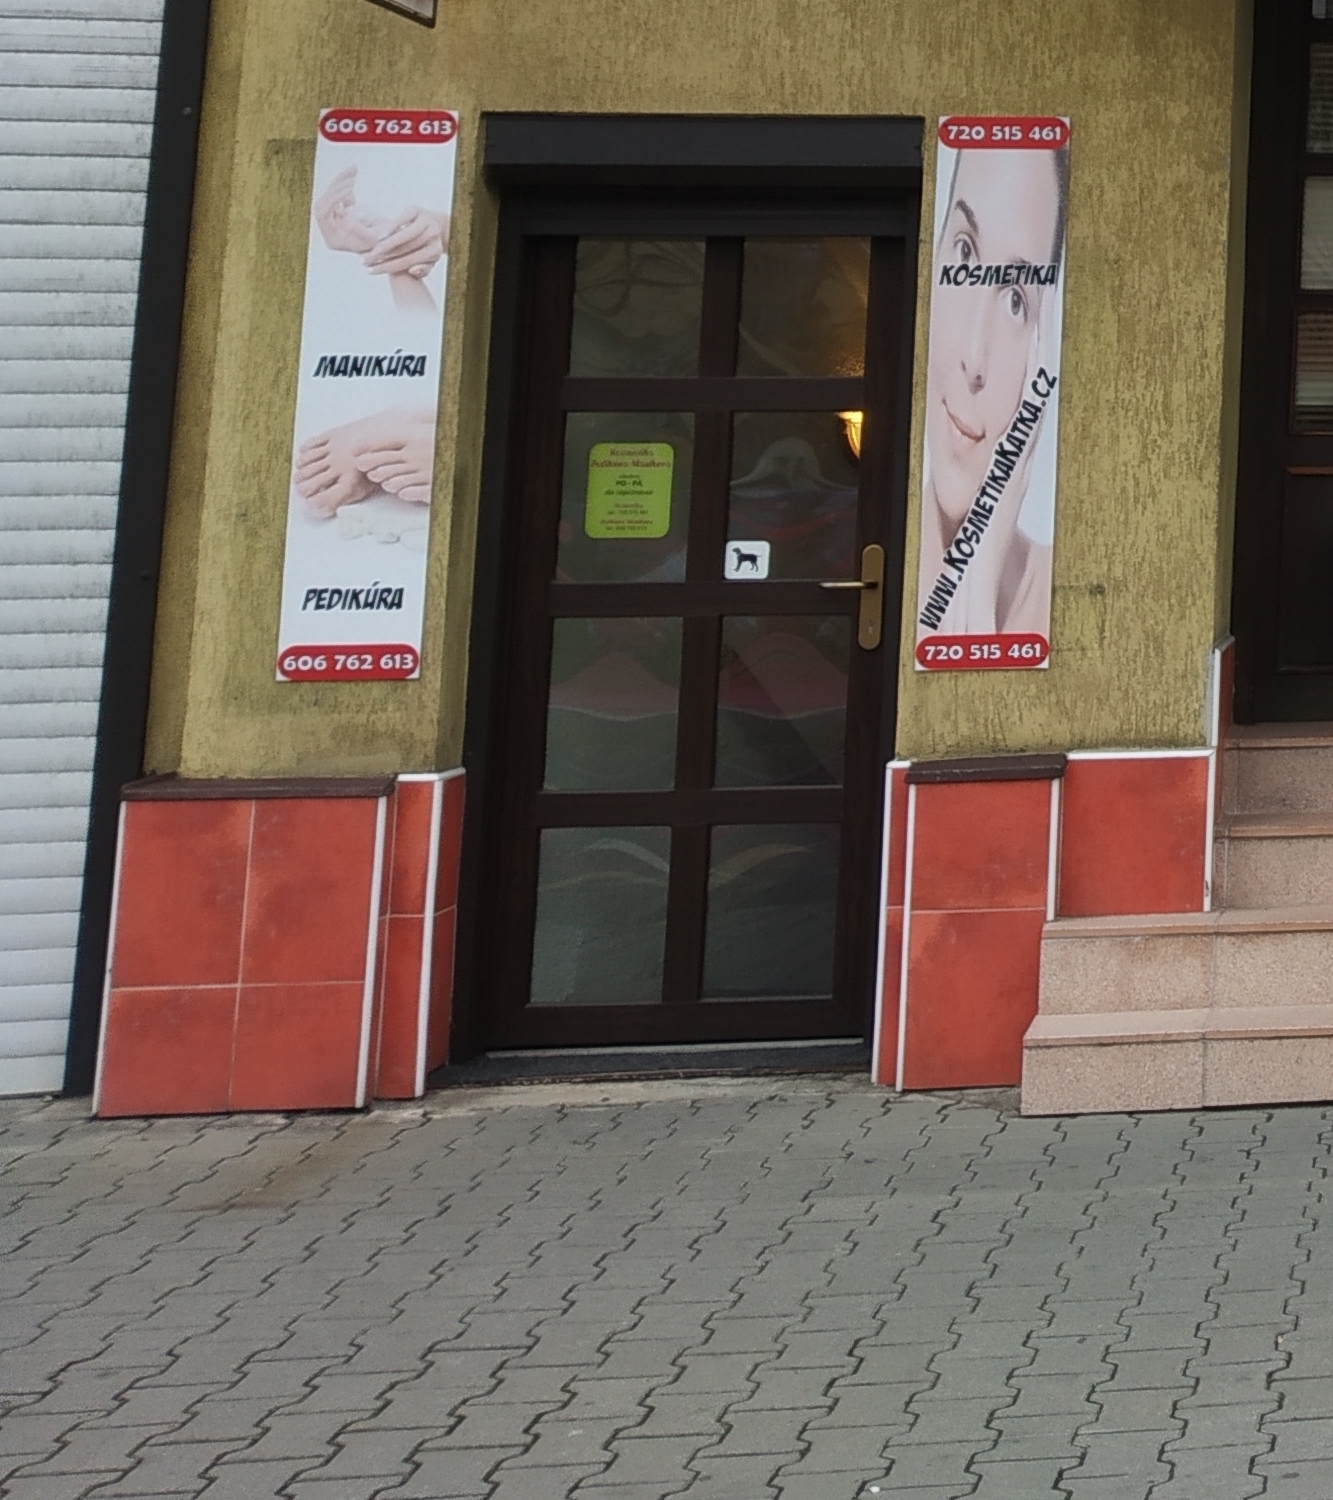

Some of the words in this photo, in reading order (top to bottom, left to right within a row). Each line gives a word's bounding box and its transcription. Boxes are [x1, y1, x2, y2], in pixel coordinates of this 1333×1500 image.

[325, 118, 368, 133] 606
[374, 119, 412, 134] 762
[418, 120, 452, 135] 613
[947, 125, 985, 140] 720
[991, 125, 1023, 140] 515
[1028, 126, 1061, 140] 461
[939, 264, 1057, 287] KOSMETIKA
[313, 349, 427, 378] MANIKÚRA
[302, 580, 404, 611] PEDIKÚRA
[924, 645, 963, 660] 720
[969, 644, 1001, 659] 515
[1008, 643, 1041, 658] 461
[283, 655, 327, 671] 606
[334, 654, 373, 671] 762
[380, 653, 414, 670] 613
